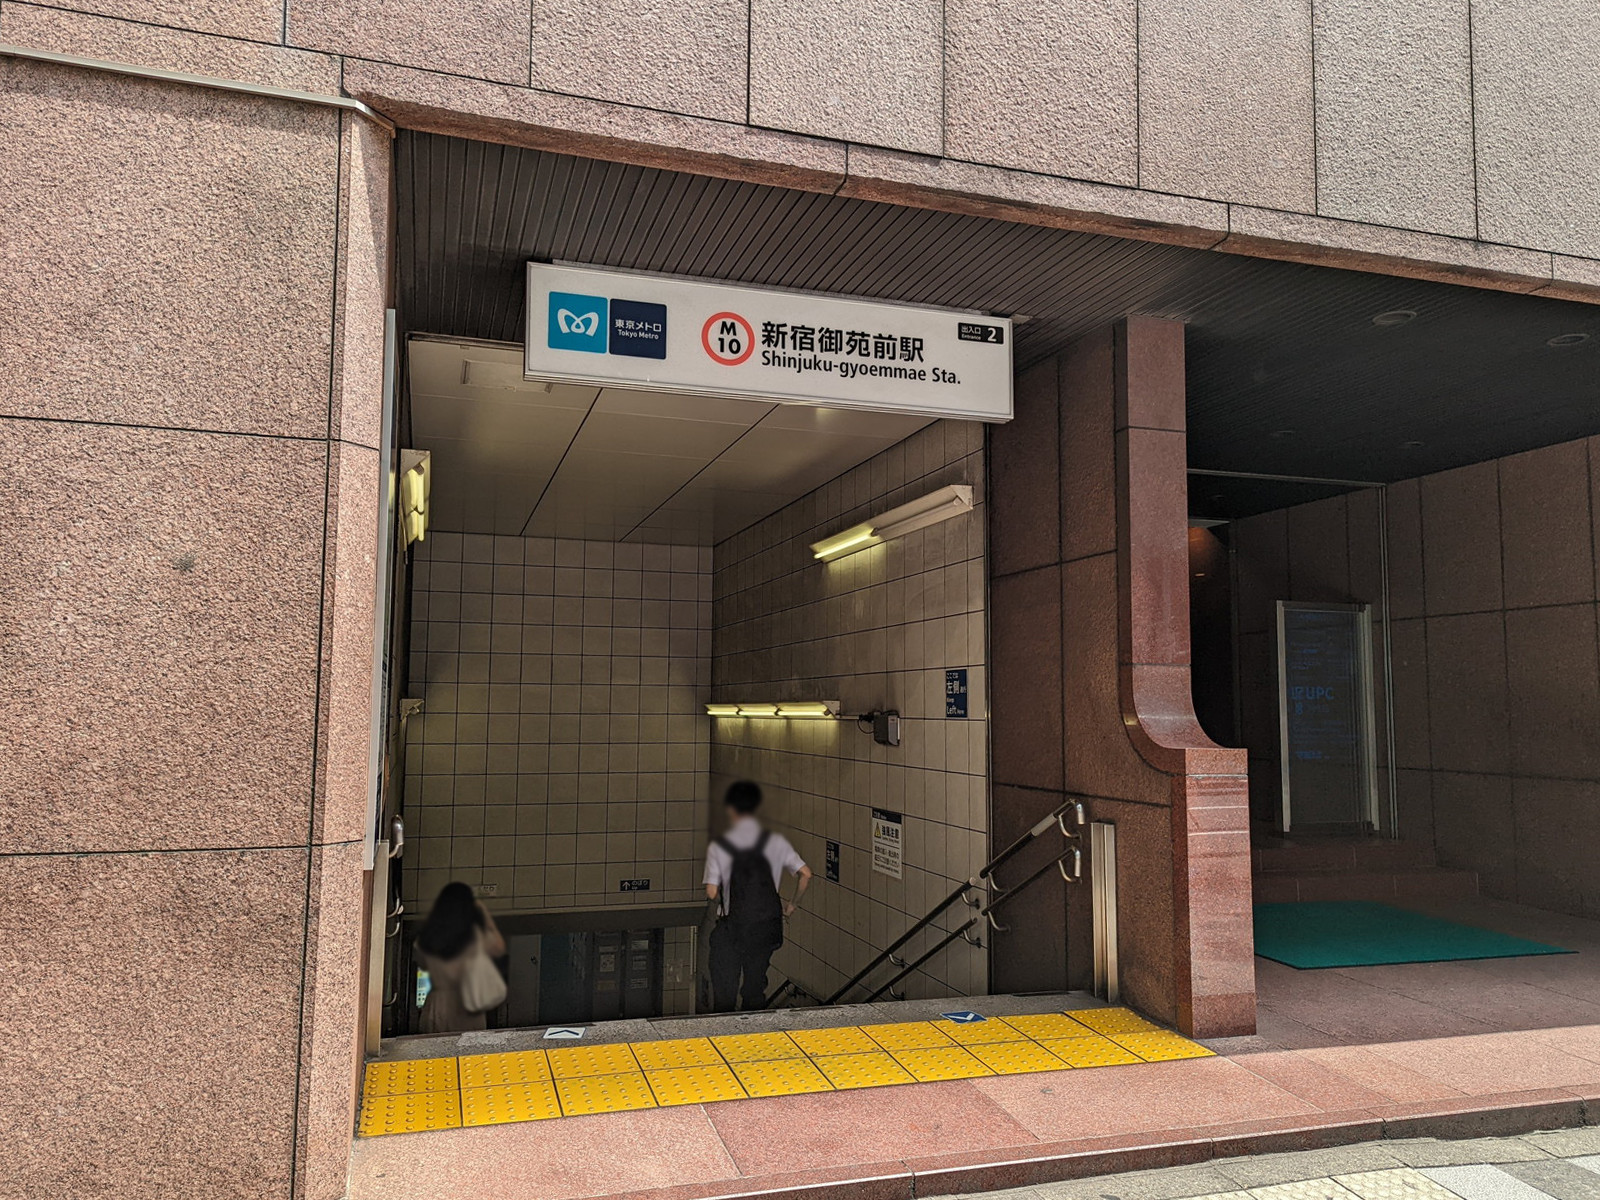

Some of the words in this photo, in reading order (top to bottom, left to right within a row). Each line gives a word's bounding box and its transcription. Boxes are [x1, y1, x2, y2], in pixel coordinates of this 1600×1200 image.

[615, 319, 661, 332] 東京メトロ
[720, 321, 737, 336] M
[961, 325, 981, 335] 出入口
[618, 329, 637, 338] Tokyo
[639, 331, 659, 340] Metro
[761, 321, 924, 363] 新宿御苑前駅
[987, 327, 997, 342] 2
[718, 338, 741, 354] 10
[761, 351, 927, 381] Shinjuku-gyoemmae
[932, 368, 961, 384] Sta.
